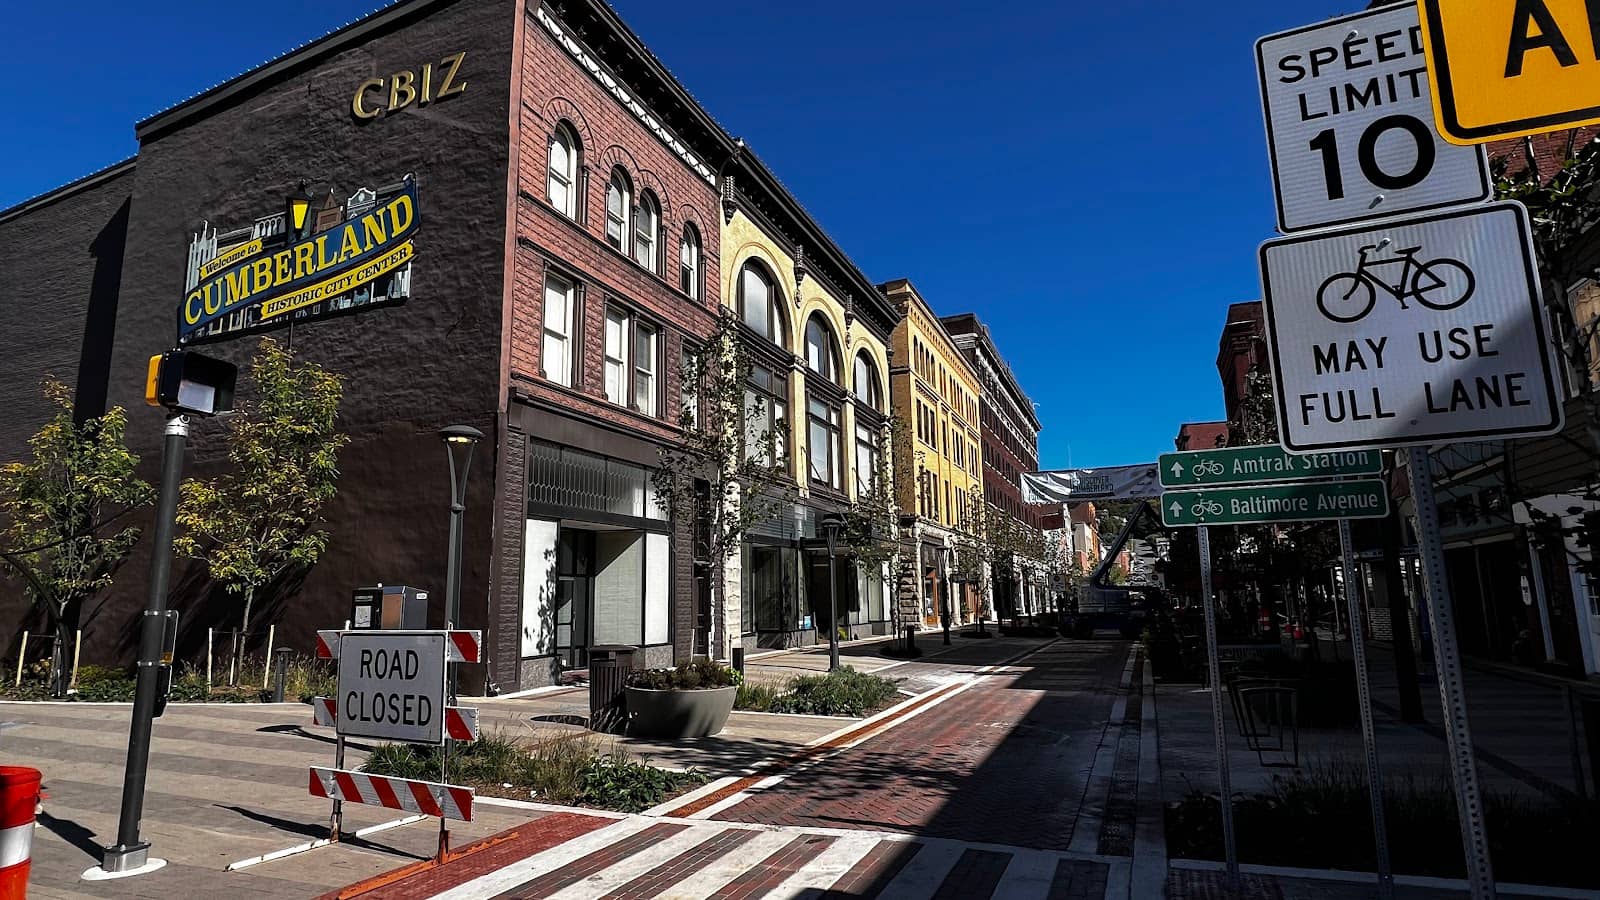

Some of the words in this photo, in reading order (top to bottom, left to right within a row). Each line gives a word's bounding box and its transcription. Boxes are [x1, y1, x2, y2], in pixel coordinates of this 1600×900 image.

[1504, 0, 1600, 78] A
[352, 51, 467, 119] CBIZ
[1298, 66, 1427, 121] LIMIT
[1309, 114, 1436, 201] 10
[184, 194, 414, 325] CUMBERLAND
[205, 249, 246, 274] Welcome
[247, 243, 258, 256] to
[267, 288, 322, 314] HISTORIC
[325, 275, 354, 296] CITY
[356, 248, 408, 282] CENTER
[1312, 336, 1388, 376] MAY
[1418, 324, 1499, 364] USE
[1300, 387, 1395, 426] FULL
[1424, 372, 1531, 415] LANE
[1232, 454, 1294, 475] Amtrak
[1302, 451, 1369, 470] Station
[1231, 495, 1308, 515] Baltimore
[1317, 493, 1378, 511] Avenue
[360, 649, 419, 680] ROAD
[346, 691, 432, 726] CLOSED
